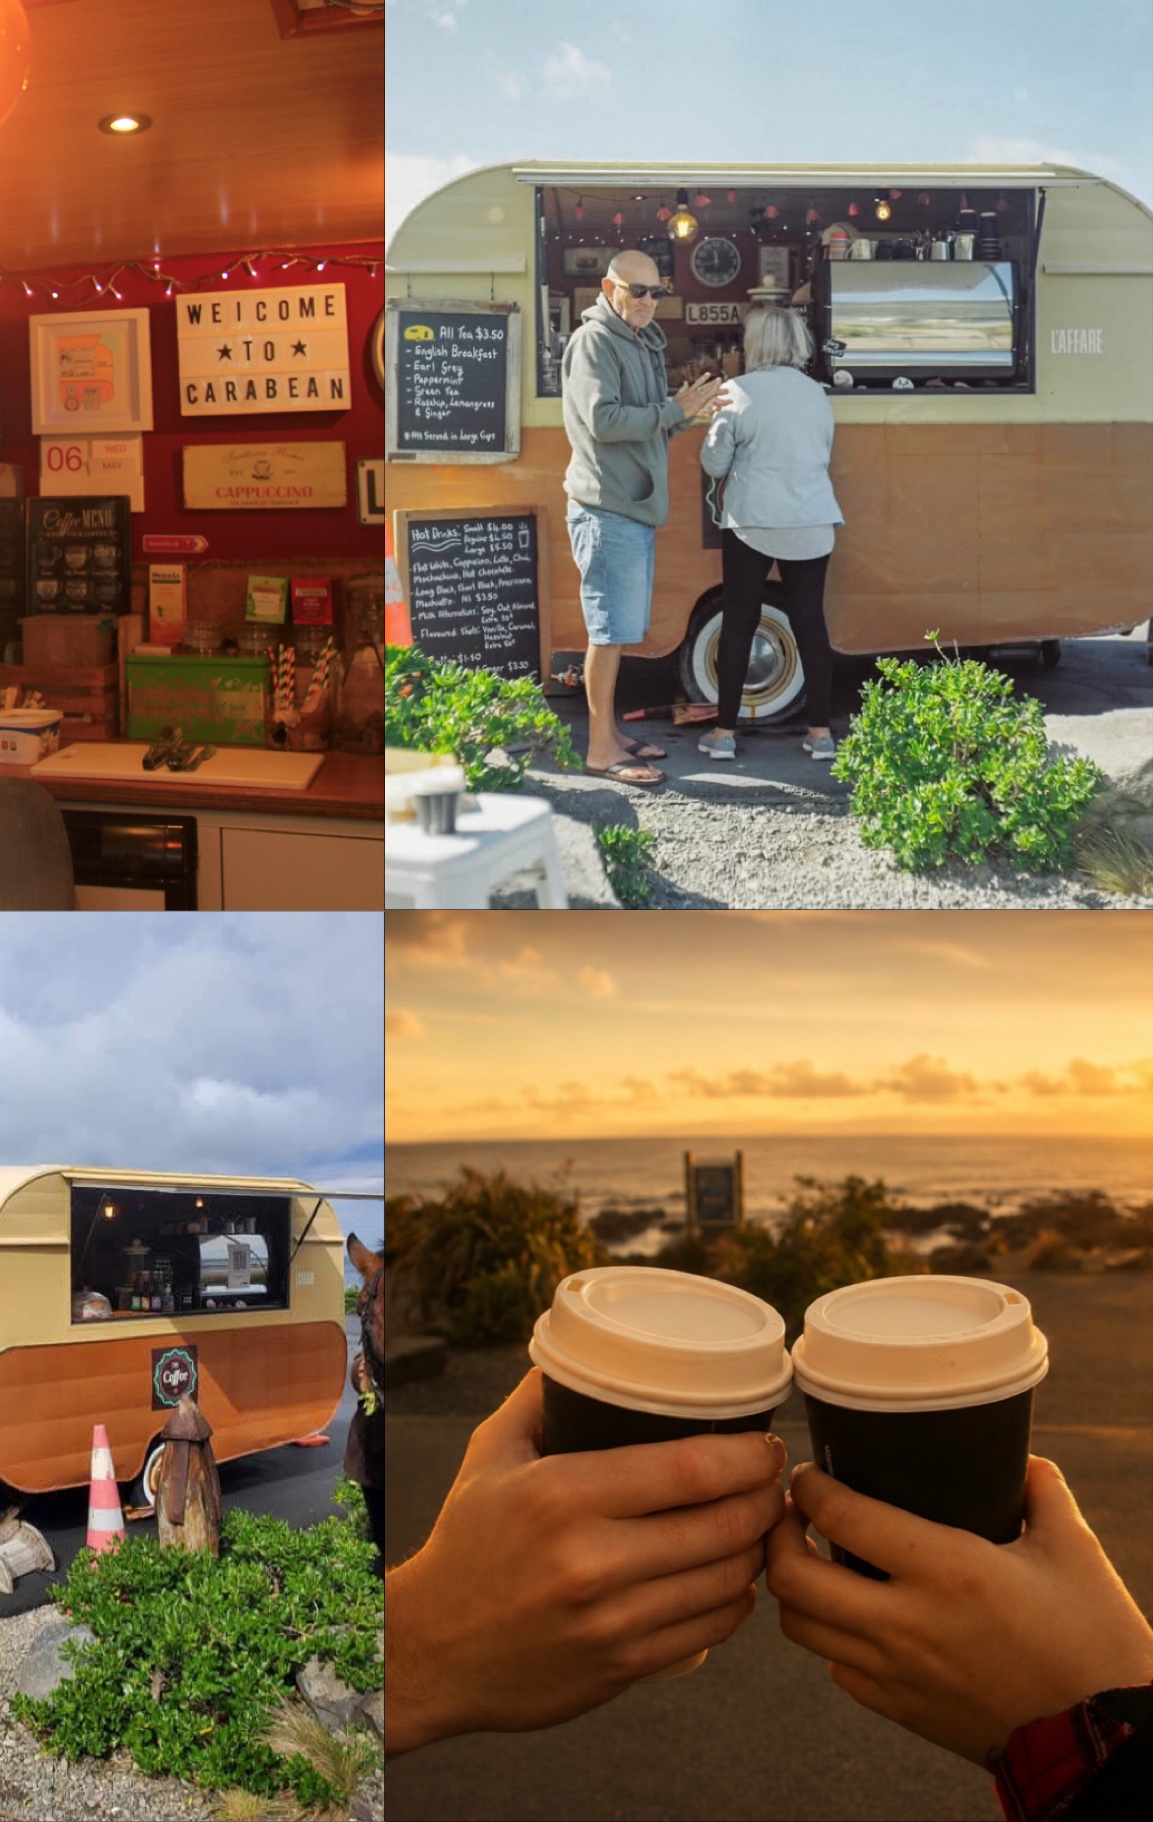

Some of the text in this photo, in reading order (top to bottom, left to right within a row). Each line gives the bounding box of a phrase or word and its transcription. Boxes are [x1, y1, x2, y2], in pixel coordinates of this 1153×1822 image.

[687, 304, 741, 323] L855A
[439, 325, 504, 341] All Tea $3.50
[1050, 328, 1104, 355] L'AFFARE
[242, 340, 276, 362] TO
[414, 344, 497, 362] English Breakfast
[413, 361, 463, 376] Earl Grey
[413, 374, 464, 385] Peppermint
[186, 376, 344, 405] CARABEAN
[414, 385, 460, 397] Green Tea
[450, 397, 495, 411] Lemongrass
[425, 408, 451, 420] Ginger
[480, 430, 496, 442] Cups
[104, 444, 127, 454] WED
[47, 446, 83, 472] 06
[102, 461, 123, 470] MAY
[215, 485, 313, 499] CAPPUCCINO
[42, 508, 112, 537] Coffee MENU
[463, 523, 483, 533] Small
[411, 527, 430, 541] Hot
[463, 533, 488, 545] Regular
[464, 545, 486, 556] Large
[413, 561, 428, 573] Flat
[462, 568, 476, 579] Hot
[415, 587, 435, 598] Long
[457, 582, 476, 592] Short
[461, 594, 472, 604] All
[418, 611, 436, 621] Milk
[163, 1370, 188, 1386] Coffee
